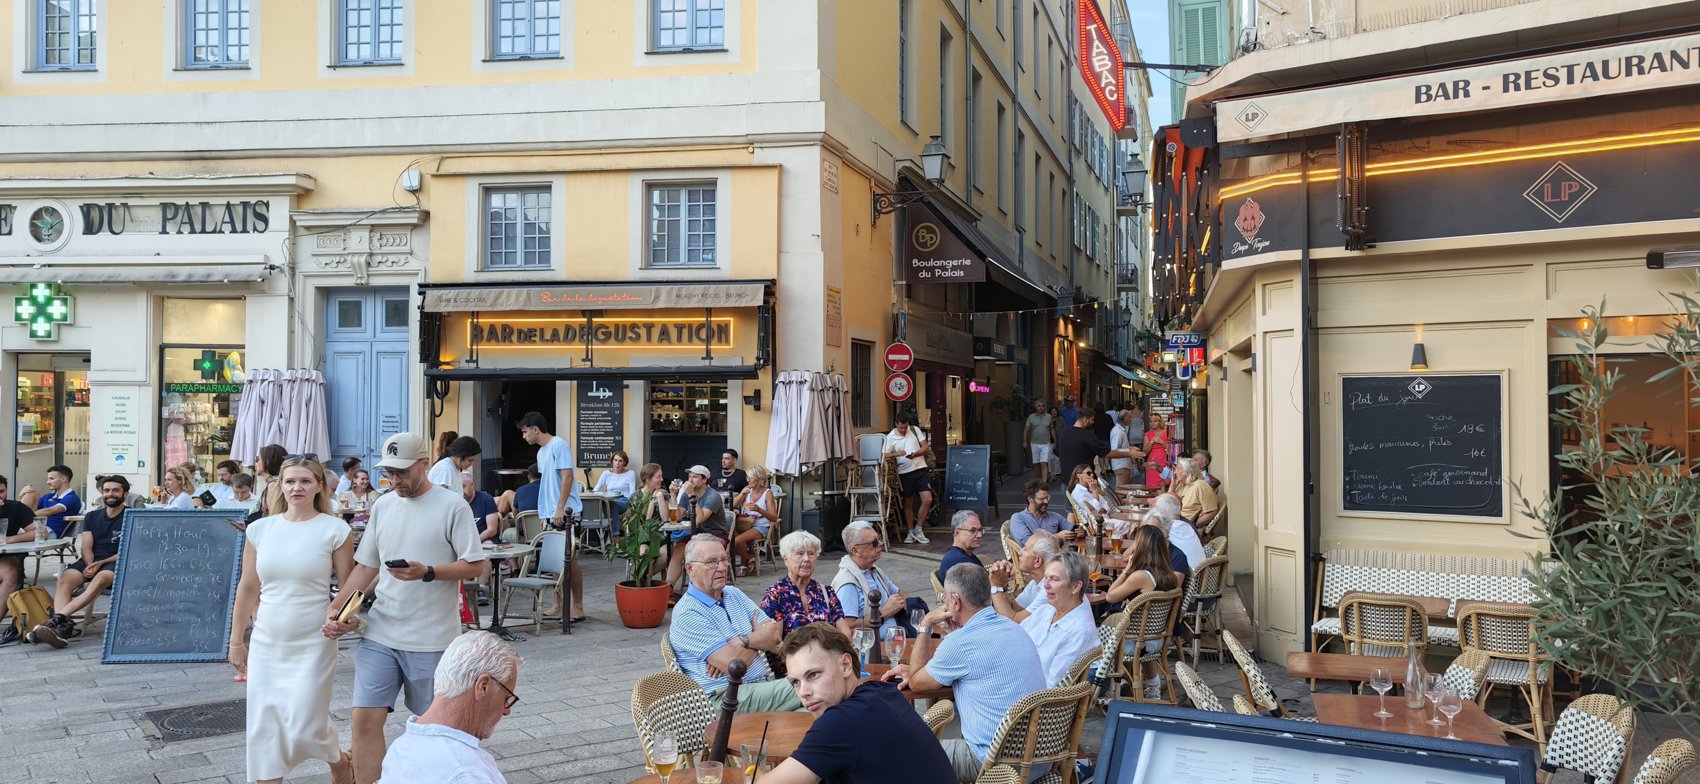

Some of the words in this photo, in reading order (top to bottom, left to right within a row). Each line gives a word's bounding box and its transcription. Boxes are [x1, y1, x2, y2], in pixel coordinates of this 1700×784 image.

[1086, 24, 1118, 101] TABAC
[1413, 79, 1471, 105] BAR
[1245, 112, 1260, 122] LP
[1543, 181, 1580, 203] LP
[81, 203, 128, 235] DU
[159, 200, 270, 235] PALAIS
[919, 228, 937, 248] BP
[912, 258, 972, 269] Boulangerie
[918, 269, 931, 278] du
[935, 268, 965, 277] Palais
[676, 292, 700, 300] HEALTHY
[725, 292, 750, 300] BRUNCH
[472, 323, 514, 344] BAR
[516, 327, 537, 343] DE
[538, 328, 562, 343] LA
[562, 322, 730, 344] DEGUSTATION
[1171, 335, 1191, 344] FDJ
[170, 383, 243, 393] PARAPHARMACY
[974, 385, 990, 394] OPEN
[1414, 384, 1426, 392] LP
[1349, 391, 1373, 411] Plat
[1378, 392, 1390, 403] du
[134, 520, 169, 543] Happy
[173, 525, 208, 541] Hour
